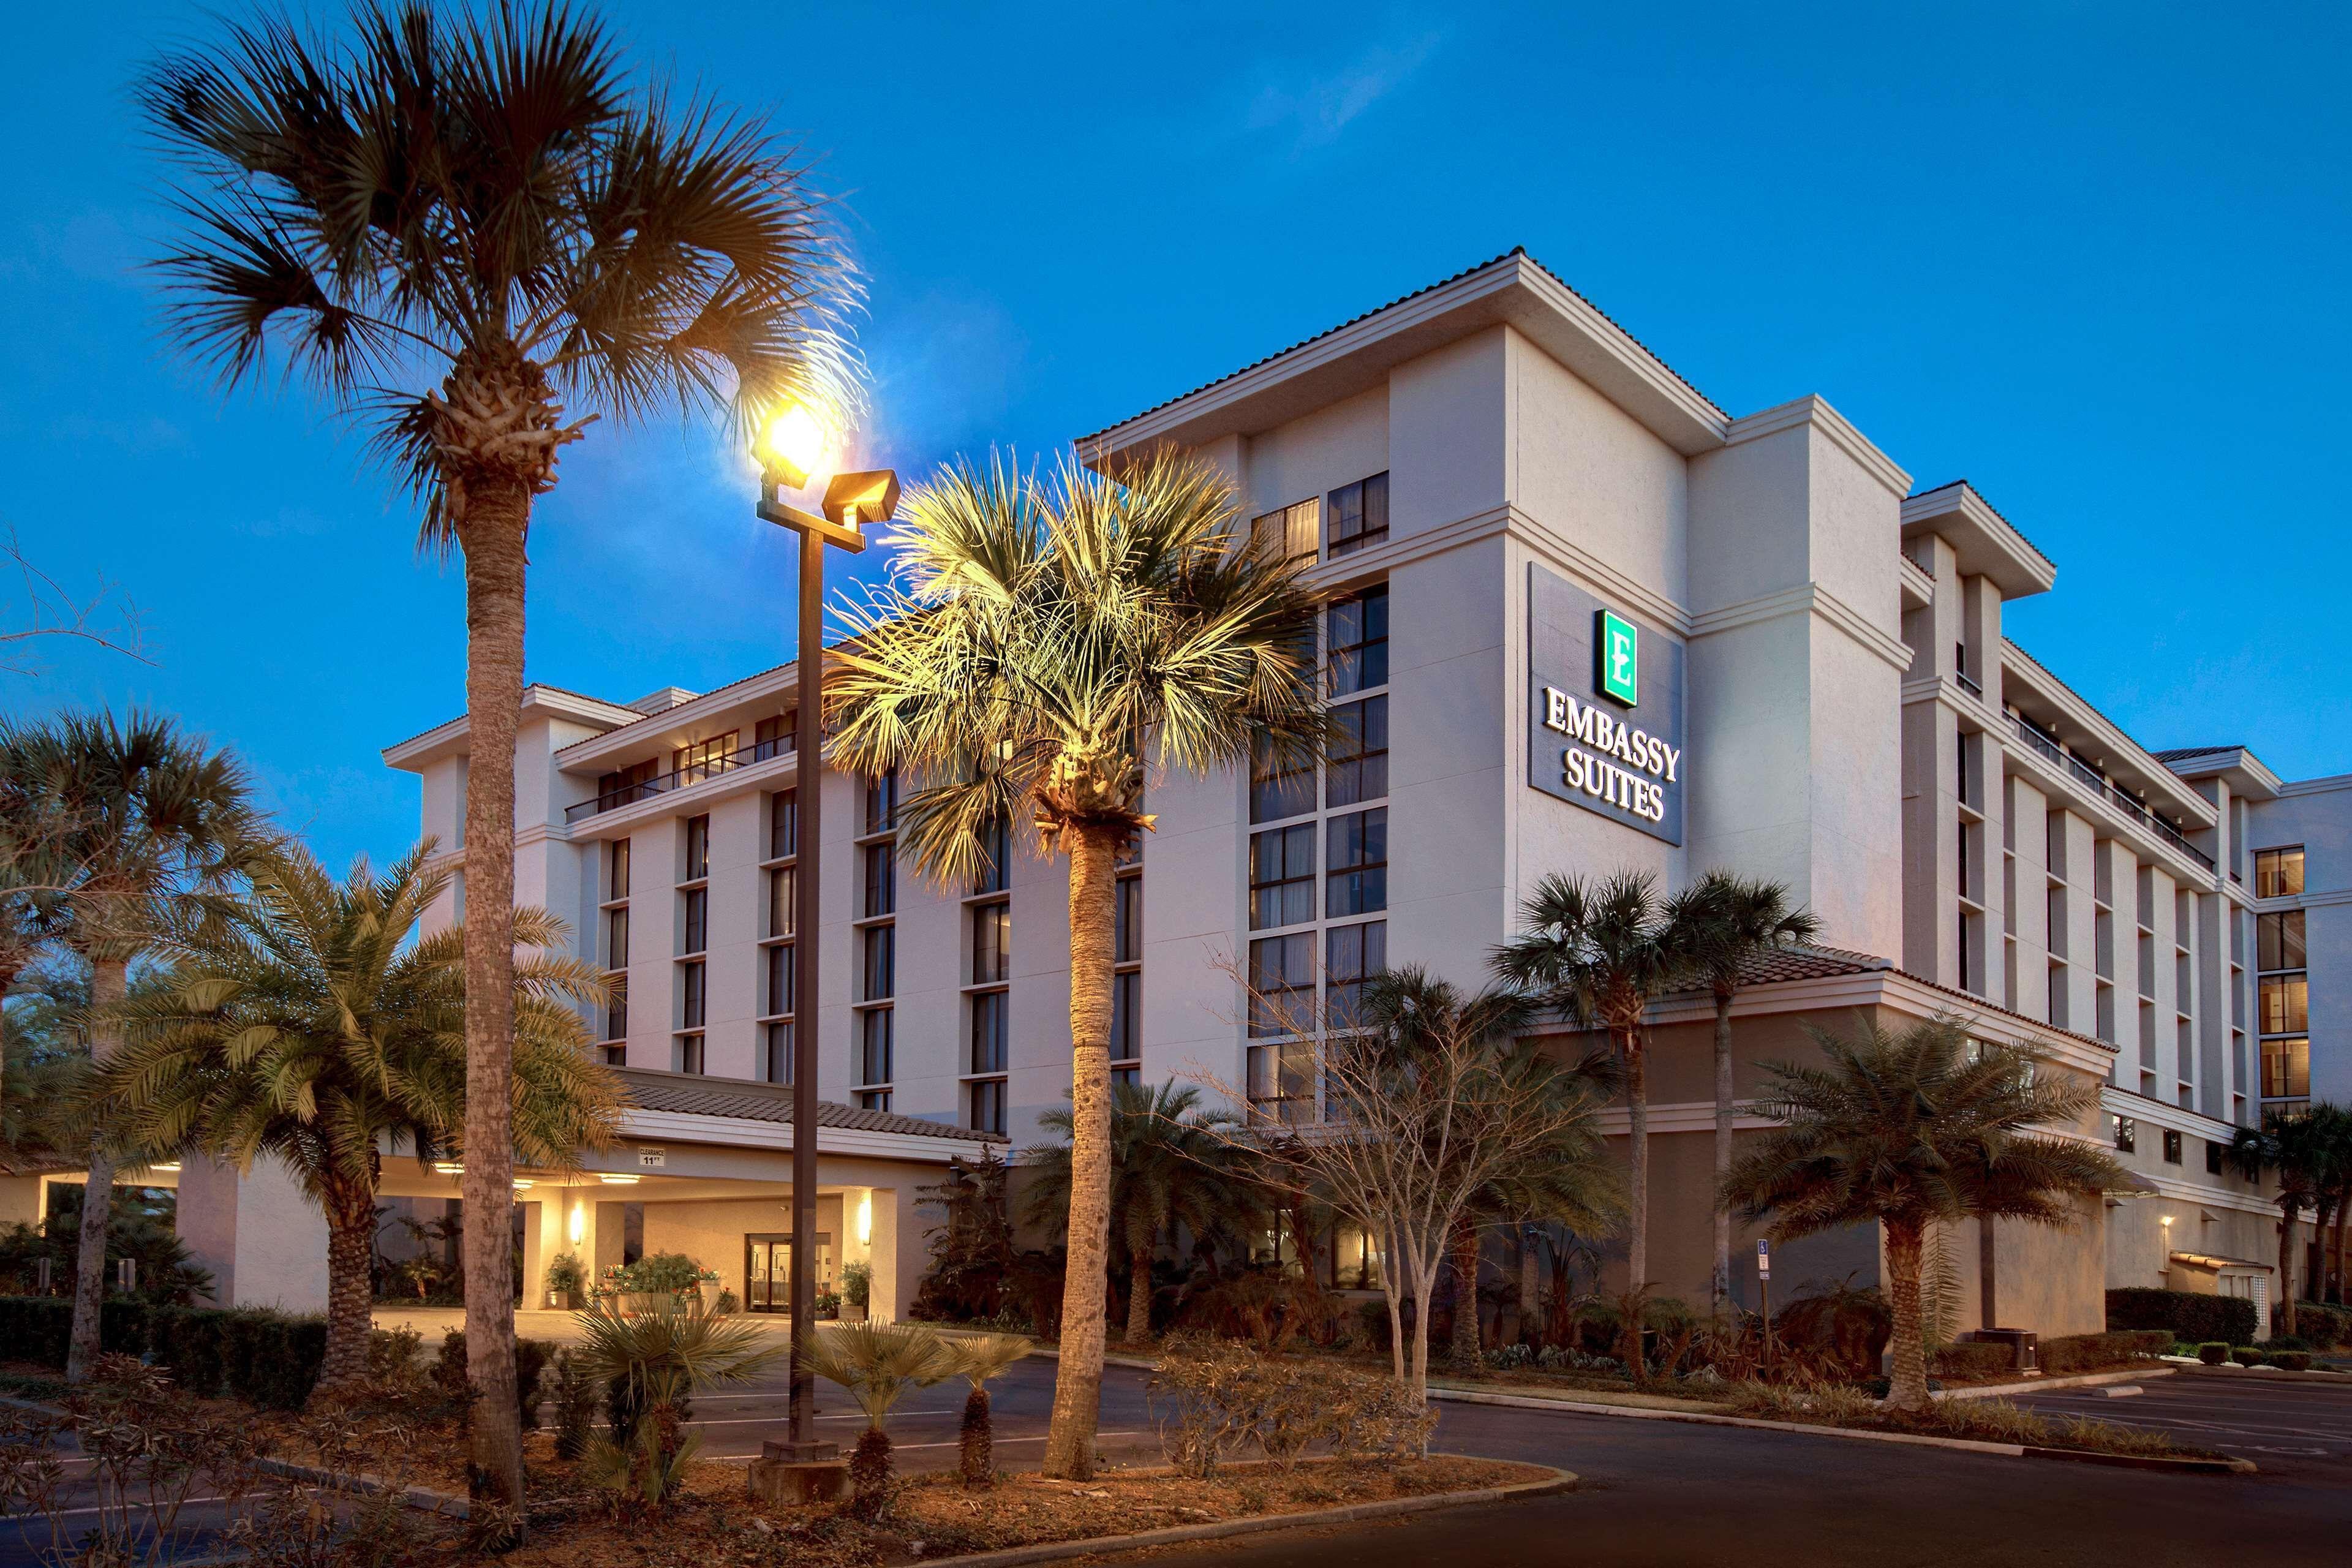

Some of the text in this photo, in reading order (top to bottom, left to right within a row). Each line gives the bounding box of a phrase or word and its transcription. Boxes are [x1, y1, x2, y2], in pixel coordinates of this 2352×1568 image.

[1612, 630, 1630, 686] E
[1544, 686, 1680, 782] EMBASSY
[1564, 748, 1664, 821] SUITES
